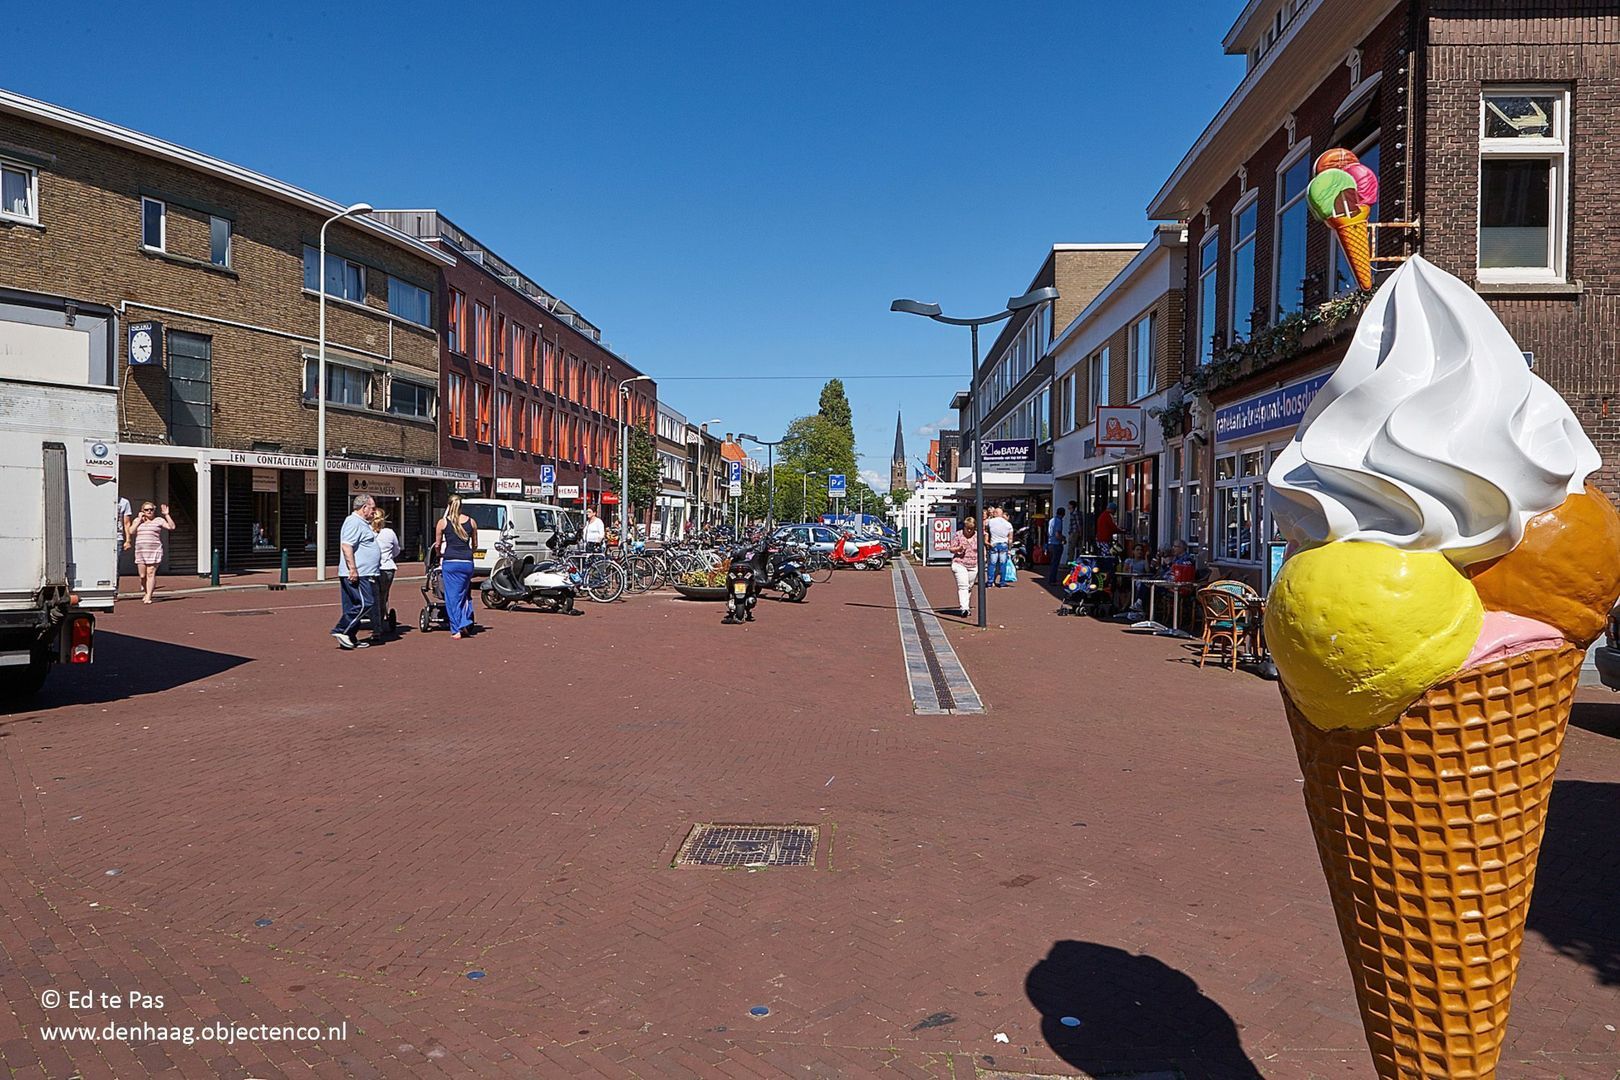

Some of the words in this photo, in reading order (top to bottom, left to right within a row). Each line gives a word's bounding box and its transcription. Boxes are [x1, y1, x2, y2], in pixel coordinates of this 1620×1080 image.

[1001, 446, 1029, 455] BATAAF
[256, 455, 318, 467] CONTACTLENZEN
[326, 460, 372, 471] OOGMETINGEN
[498, 479, 520, 489] HEMA
[558, 486, 578, 495] HEMA
[934, 520, 950, 531] OP
[934, 531, 950, 541] RUI
